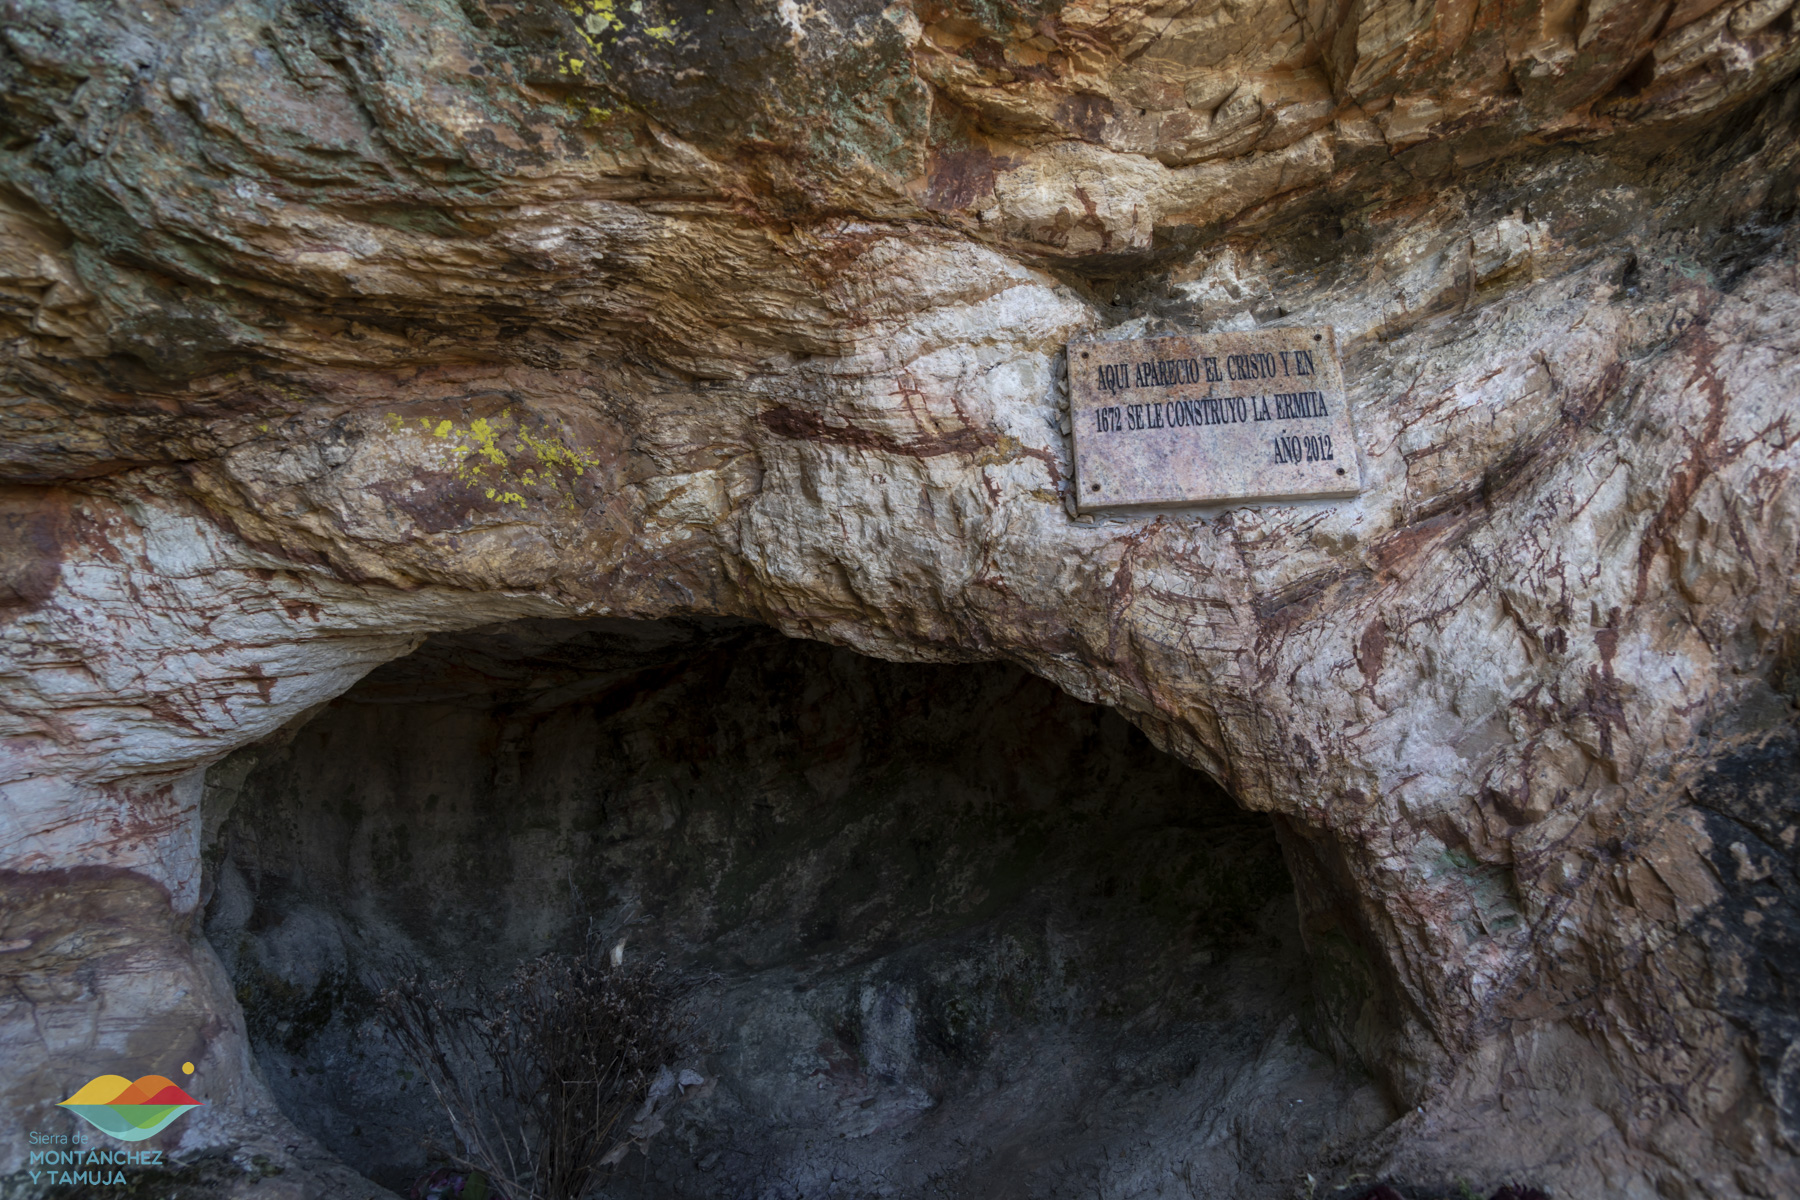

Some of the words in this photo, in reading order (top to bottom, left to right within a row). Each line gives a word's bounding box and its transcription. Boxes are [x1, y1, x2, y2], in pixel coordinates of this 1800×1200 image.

[1098, 363, 1130, 395] AQUI
[1136, 358, 1199, 388] APARECIO
[1204, 357, 1223, 382] EL
[1227, 352, 1276, 381] CRISTO
[1280, 352, 1292, 377] Y
[1295, 350, 1315, 375] EN
[1095, 406, 1122, 432] 1672
[1128, 403, 1143, 430] SE
[1147, 403, 1164, 429] LE
[1165, 396, 1247, 428] CONSTRUYO
[1251, 395, 1271, 422] LA
[1274, 391, 1328, 420] ERMITA
[1274, 429, 1302, 465] AÑO
[1303, 435, 1333, 462] 2012
